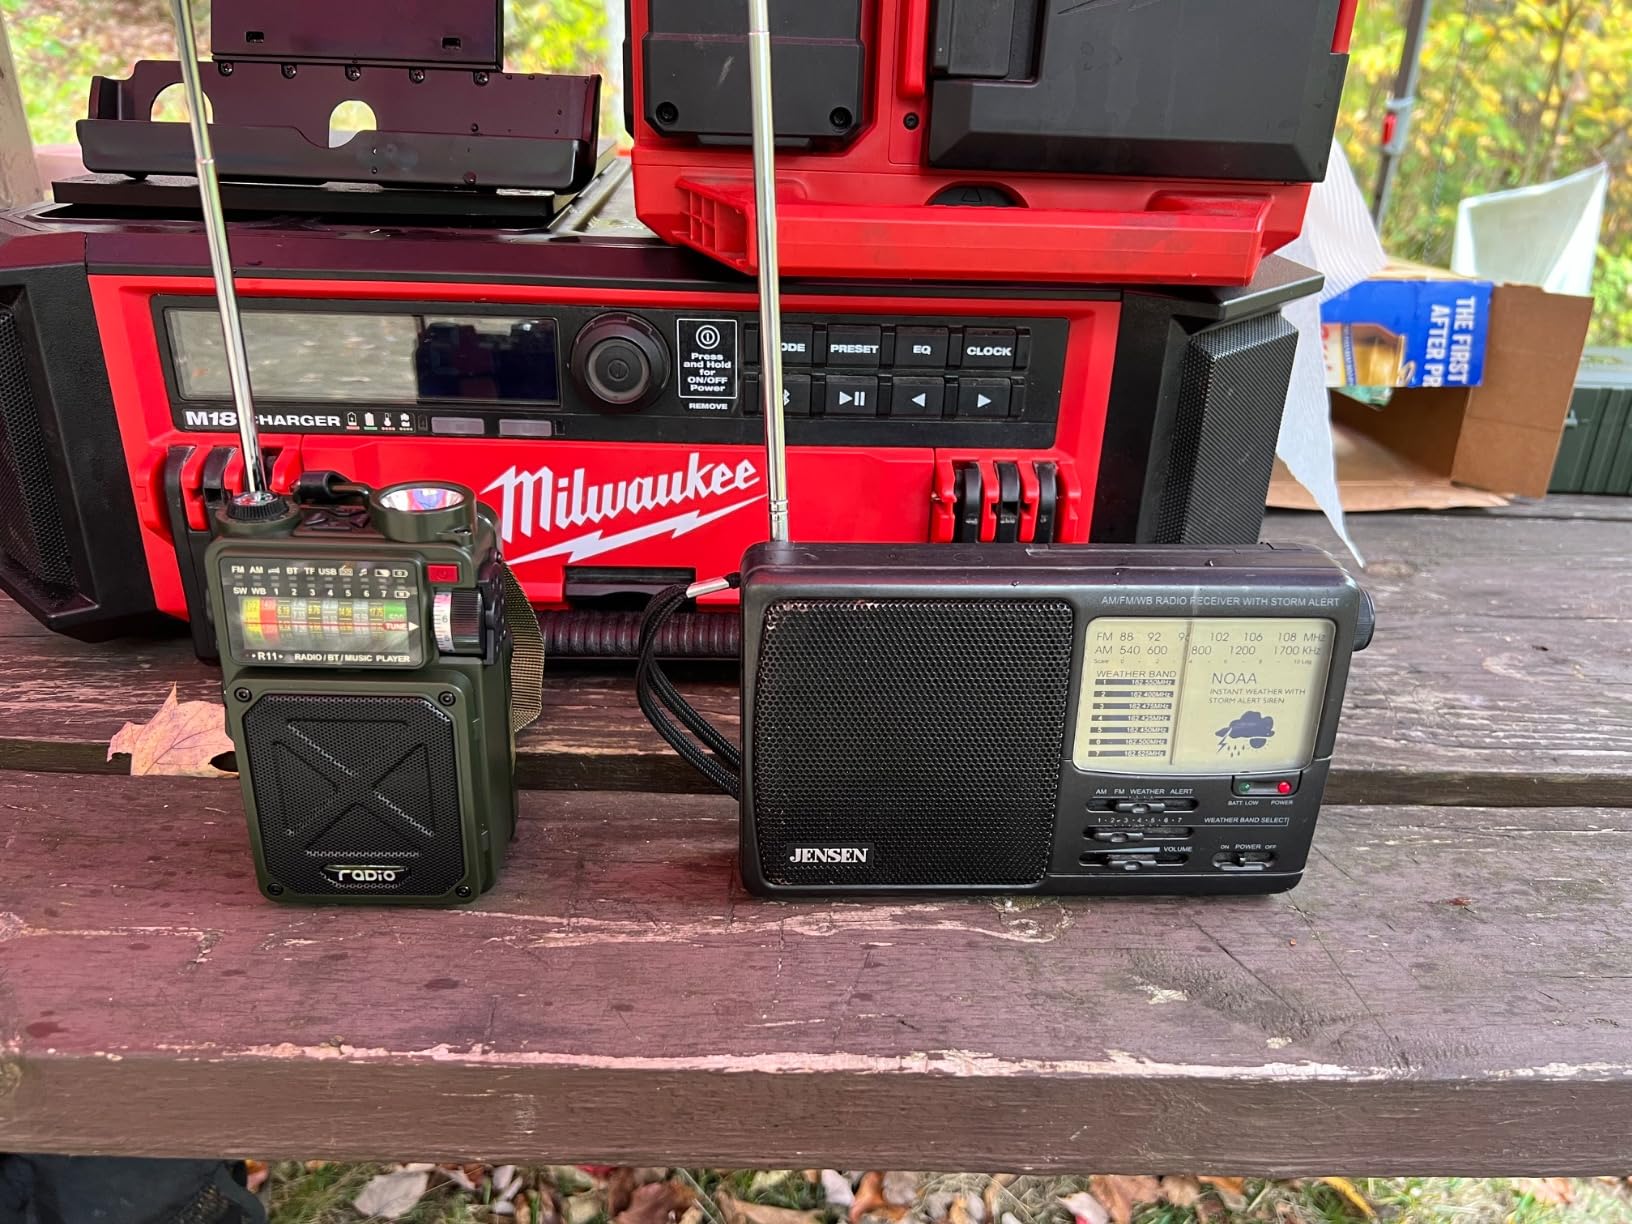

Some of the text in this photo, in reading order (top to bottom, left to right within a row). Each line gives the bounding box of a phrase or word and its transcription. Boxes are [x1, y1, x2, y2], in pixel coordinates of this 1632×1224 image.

[1426, 304, 1450, 360] AFTER
[1447, 296, 1477, 385] THE FIRST
[781, 342, 806, 352] ODE
[830, 344, 879, 354] PRESET
[913, 345, 931, 355] EQ
[967, 346, 1012, 356] CLOCK
[691, 352, 724, 361] Press
[706, 361, 732, 369] Hold
[687, 376, 728, 384] ON/OFF
[690, 384, 726, 392] Power
[689, 402, 728, 410] REMOVE
[185, 411, 341, 427] M18 HARGER
[479, 451, 761, 544] Milwaukee
[231, 565, 245, 574] FM
[249, 565, 264, 574] AM
[286, 566, 299, 575] BT
[304, 567, 316, 575] TF
[318, 567, 337, 576] USB
[233, 586, 248, 595] SW
[251, 587, 267, 595] WB
[273, 587, 279, 596] 1
[291, 588, 298, 596] 2
[309, 588, 316, 596] 3
[327, 589, 334, 597] 4
[345, 589, 352, 597] 5
[380, 590, 388, 598] 7
[1101, 596, 1340, 607] AM/FM/WB RADIO RECEIVER WITH STORM ALERT
[1096, 632, 1113, 641] FM
[1120, 632, 1134, 641] 88
[1147, 632, 1161, 642] 92
[1210, 632, 1230, 642] 102
[1244, 632, 1263, 642] 106
[1279, 632, 1297, 642] 108
[1303, 633, 1327, 642] MHz
[1094, 645, 1321, 656] AM 540 600 800 1200 1700 KHz
[294, 653, 323, 662] RADIO
[345, 653, 373, 662] MUSIC
[376, 654, 411, 663] PLAYER
[1097, 670, 1177, 678] WEATHER BAND
[1211, 672, 1257, 685] NOAA
[789, 847, 869, 863] JENSEN
